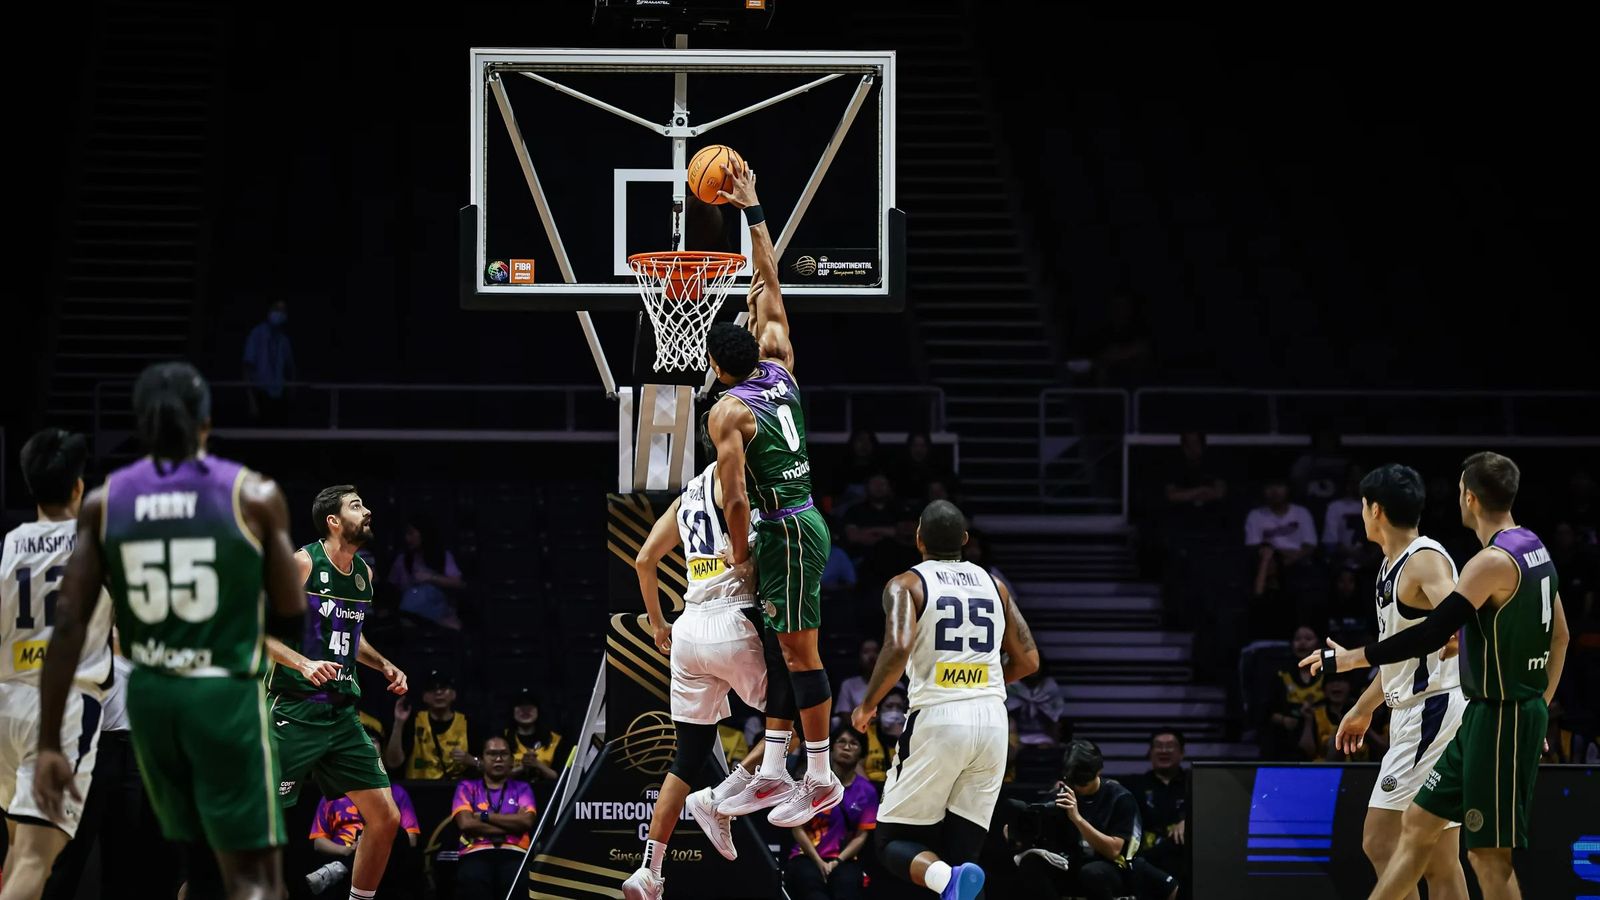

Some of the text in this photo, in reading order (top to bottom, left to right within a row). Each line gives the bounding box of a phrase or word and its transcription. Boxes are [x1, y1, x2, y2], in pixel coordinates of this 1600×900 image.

[776, 404, 800, 452] 0
[134, 491, 198, 521] PERRY
[682, 510, 715, 555] 10
[693, 559, 718, 576] MANI
[120, 537, 219, 624] 55
[935, 571, 983, 587] NEWBILL
[335, 608, 365, 623] Unicaja
[935, 596, 995, 653] 25
[329, 631, 351, 656] 45
[19, 647, 45, 664] MA
[942, 668, 982, 685] MANI
[646, 790, 660, 800] FIB
[671, 849, 703, 861] 2025
